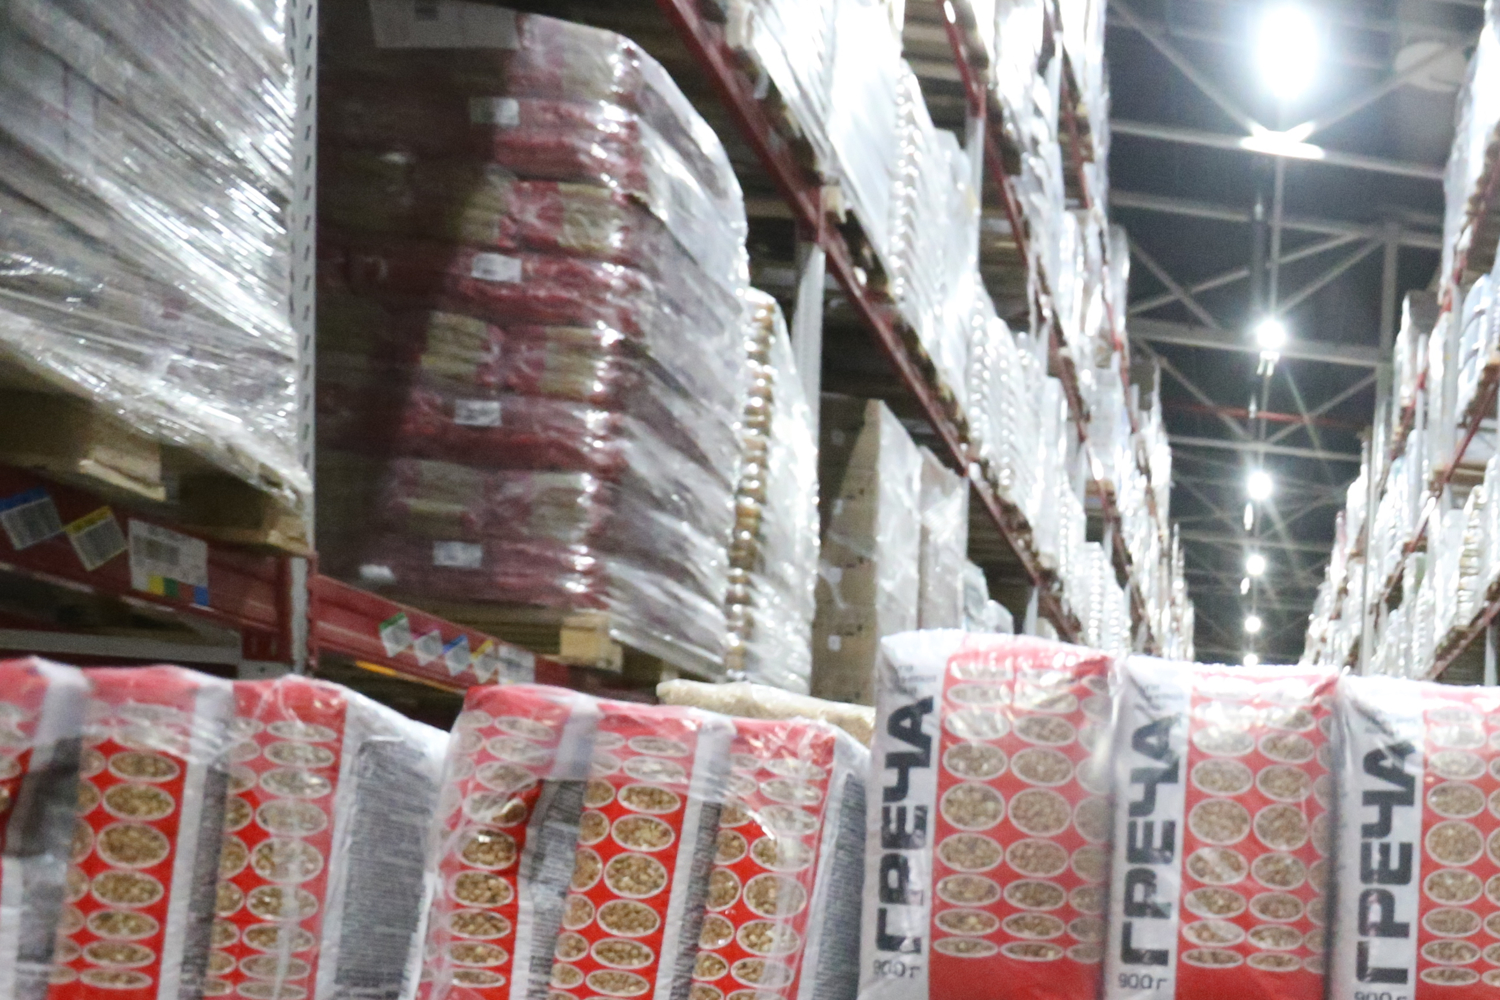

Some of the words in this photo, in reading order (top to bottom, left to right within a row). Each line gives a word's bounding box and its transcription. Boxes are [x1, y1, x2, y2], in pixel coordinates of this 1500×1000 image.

[875, 697, 934, 955] ГРЕЧА
[1119, 716, 1180, 966] ГРЕЧА
[1356, 741, 1416, 985] ГРЕЧА
